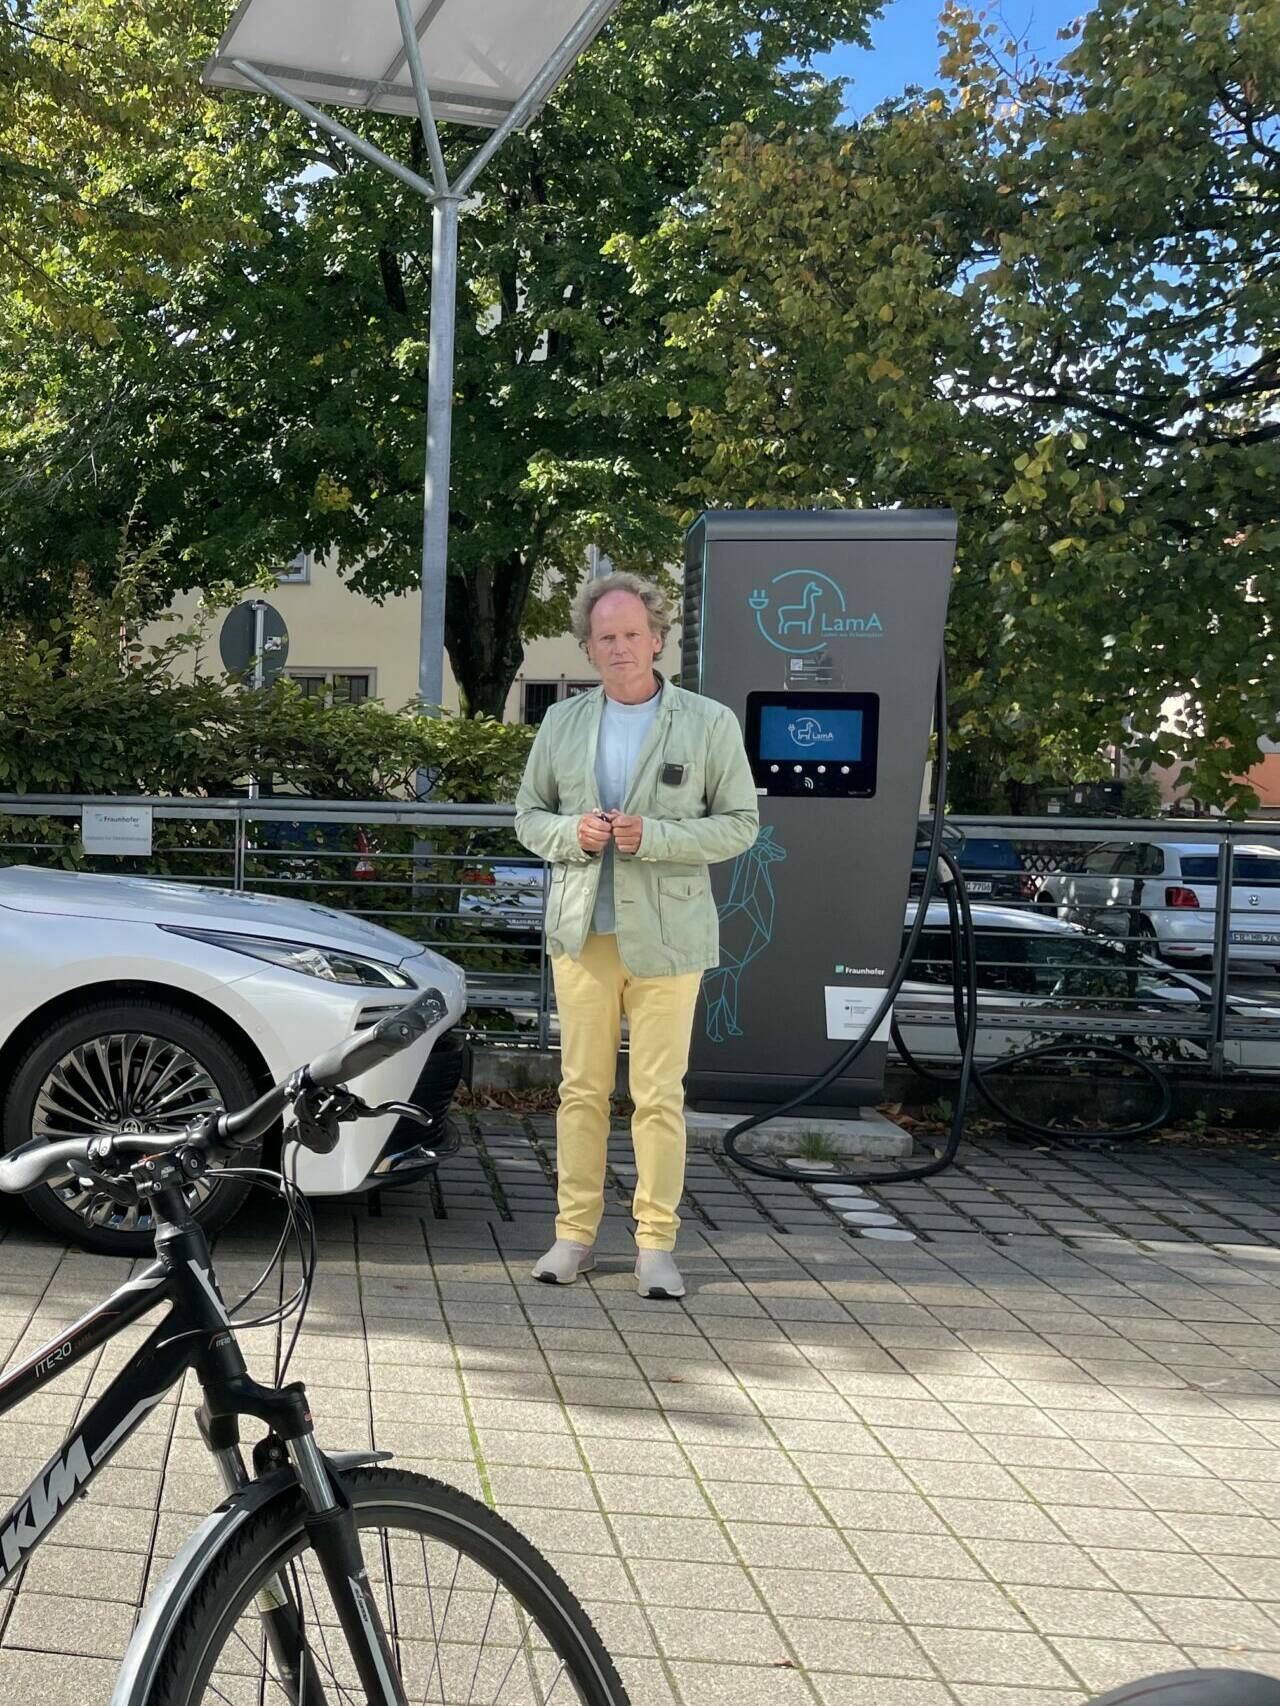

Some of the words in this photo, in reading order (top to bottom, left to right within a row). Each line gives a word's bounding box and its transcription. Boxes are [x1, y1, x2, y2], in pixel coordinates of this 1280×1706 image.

[821, 612, 883, 631] LamA
[812, 731, 833, 740] LamA
[845, 966, 885, 976] Fraunhofer
[34, 1341, 72, 1378] ITERO
[1, 1434, 92, 1572] KTM
